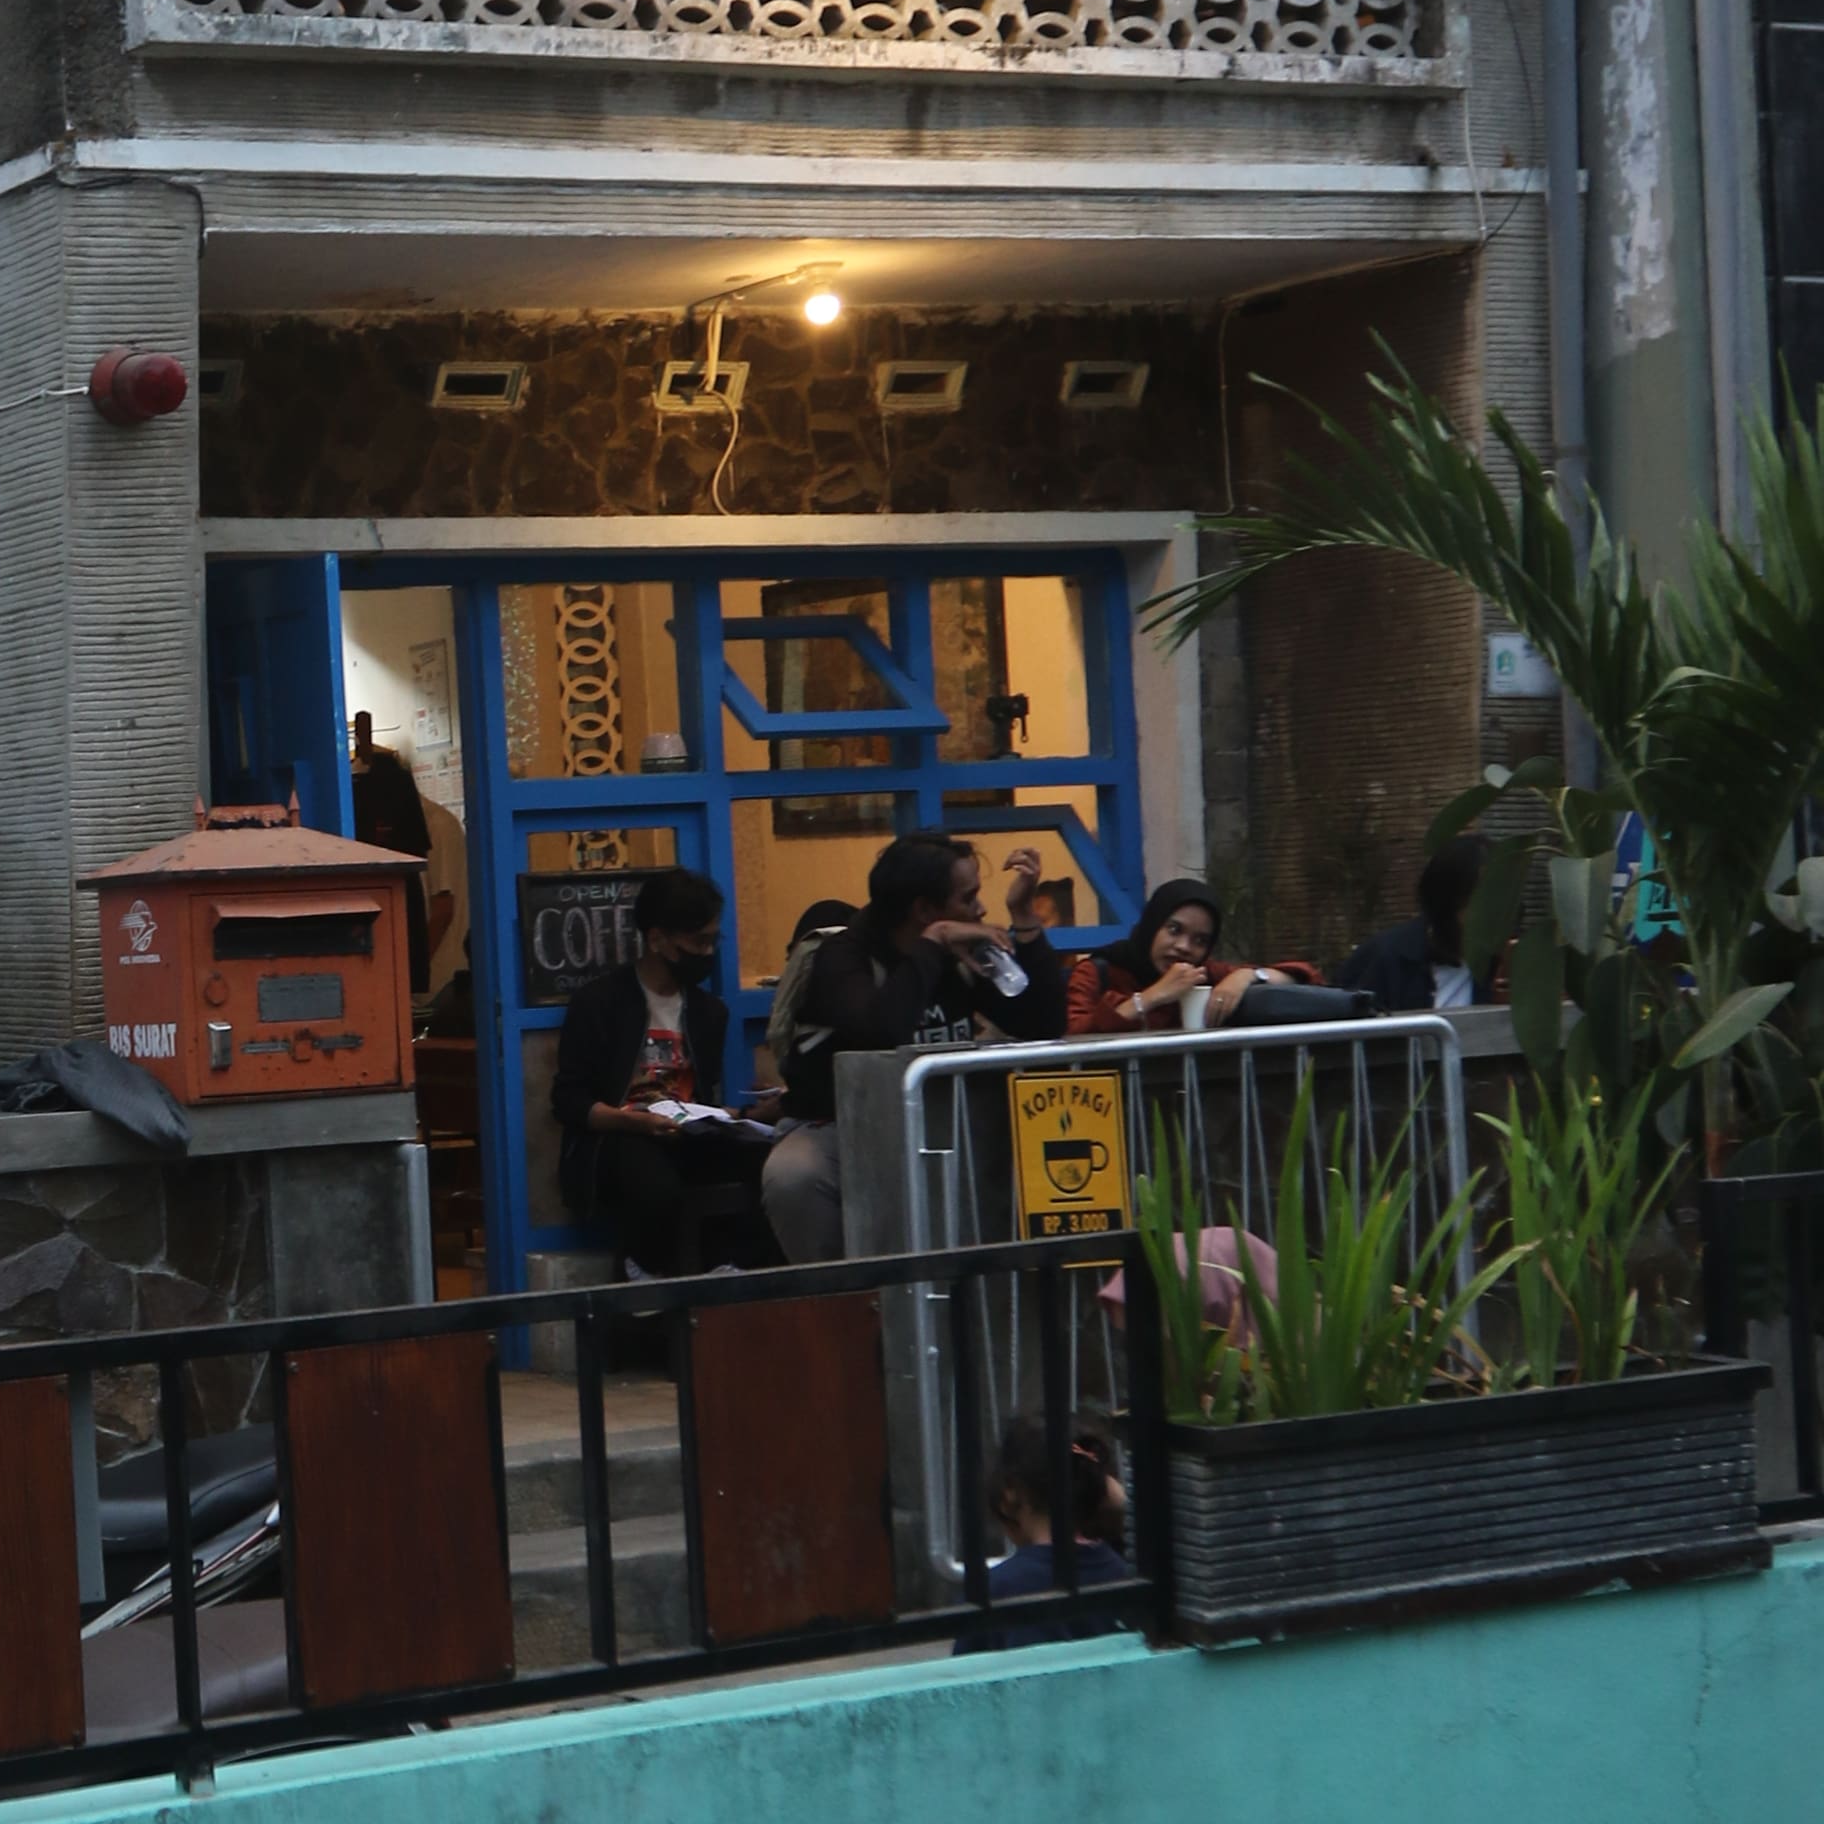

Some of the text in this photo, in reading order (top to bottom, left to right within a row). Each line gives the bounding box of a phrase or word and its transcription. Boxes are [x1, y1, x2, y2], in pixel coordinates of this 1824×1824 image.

[109, 1022, 177, 1058] BIS SURAT
[1022, 1085, 1112, 1121] KOPI PAGI
[1071, 1213, 1109, 1233] 3.000
